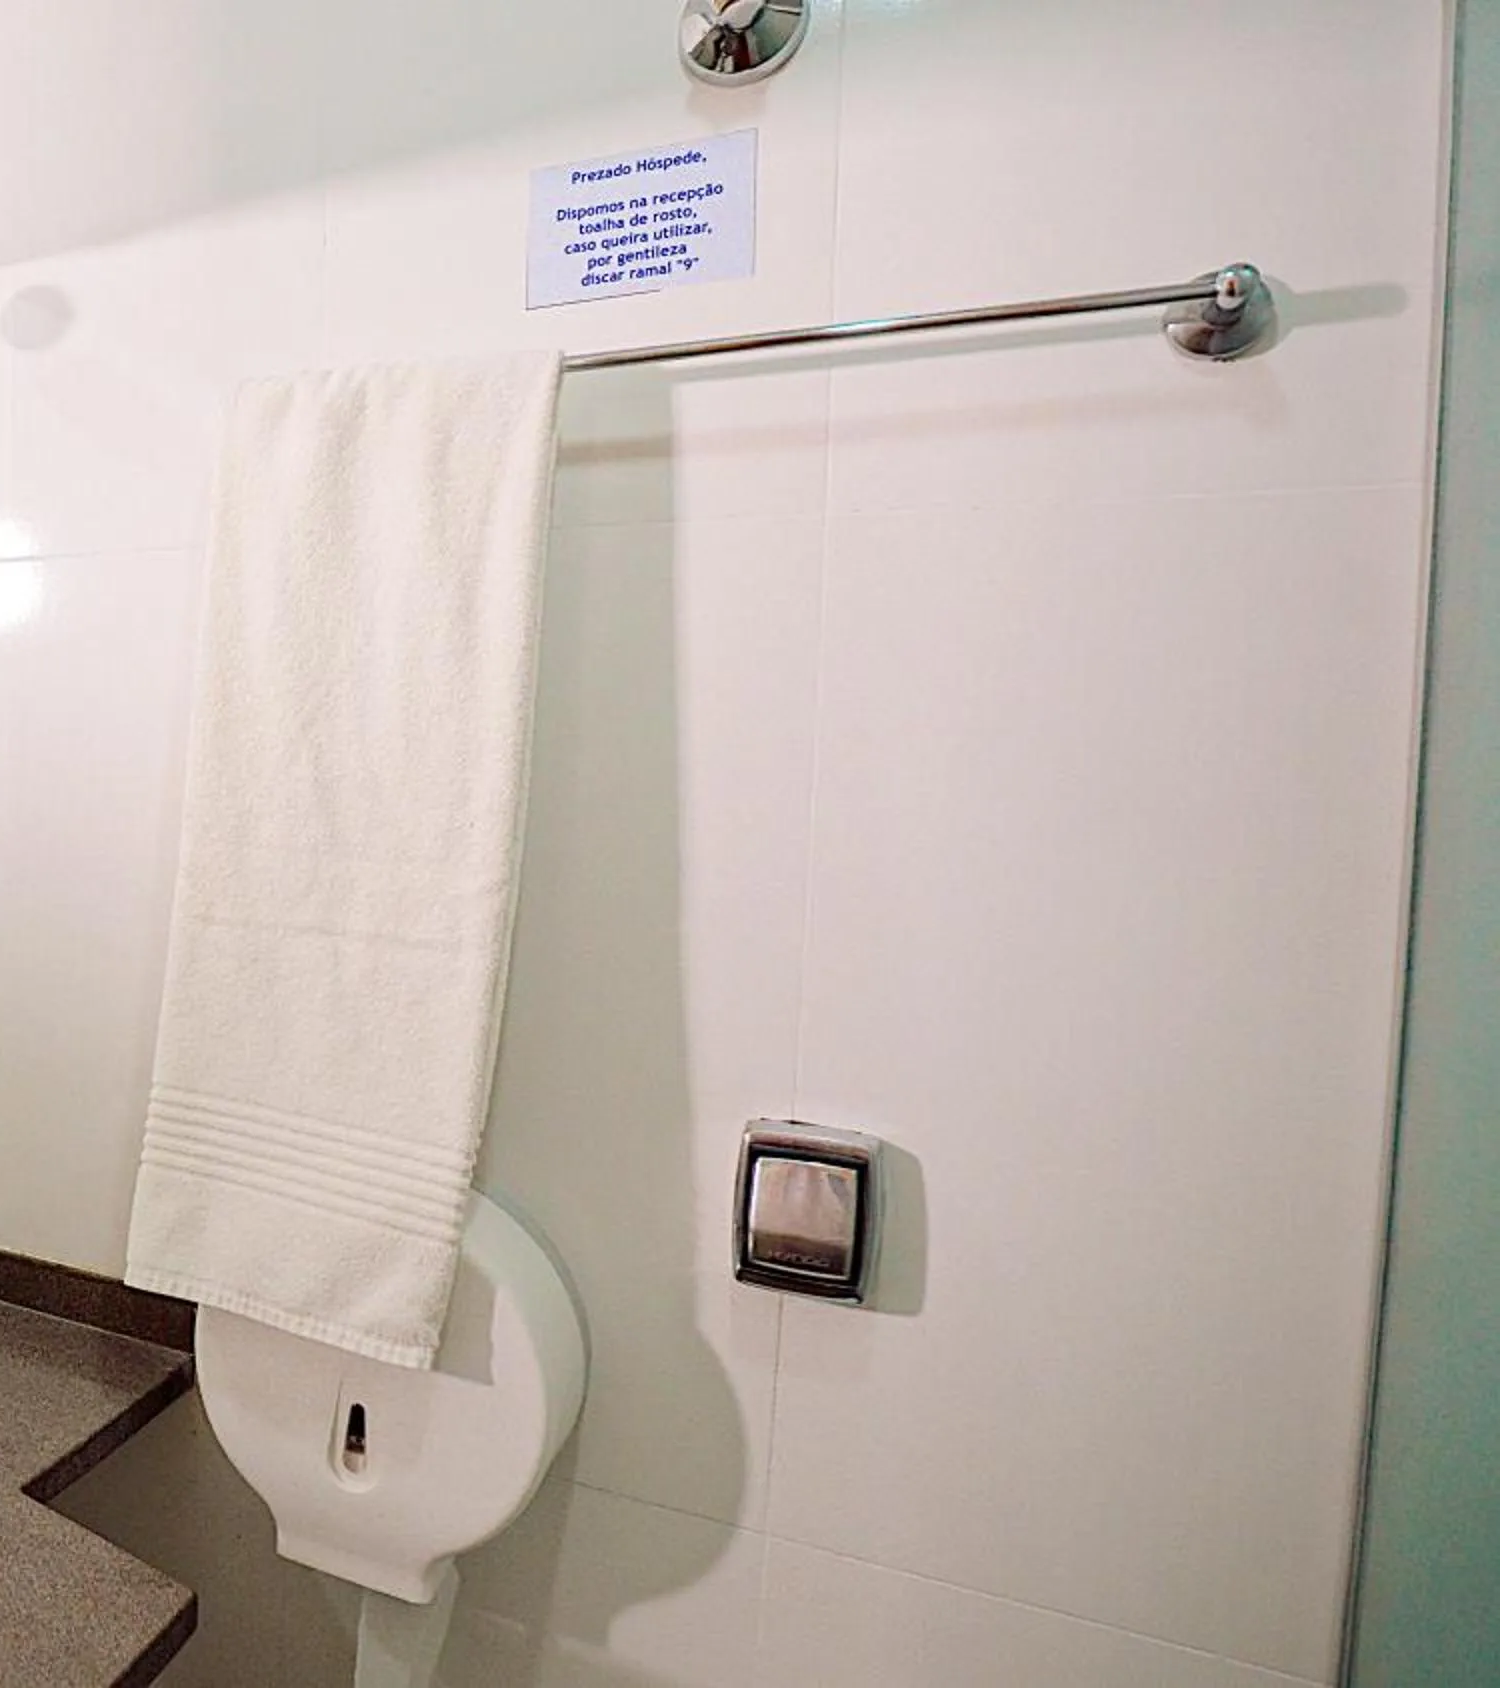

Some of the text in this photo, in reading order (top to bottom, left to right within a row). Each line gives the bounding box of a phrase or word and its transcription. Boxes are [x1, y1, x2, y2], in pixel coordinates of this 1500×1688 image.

[572, 151, 706, 184] Prezado Hóspede,
[556, 184, 724, 221] Dispomos na recepção
[578, 208, 697, 235] toalha de rosto,
[564, 222, 712, 254] caso queira utilizar,
[588, 244, 687, 271] por gentileza
[581, 271, 625, 286] discar
[630, 261, 672, 279] ramal
